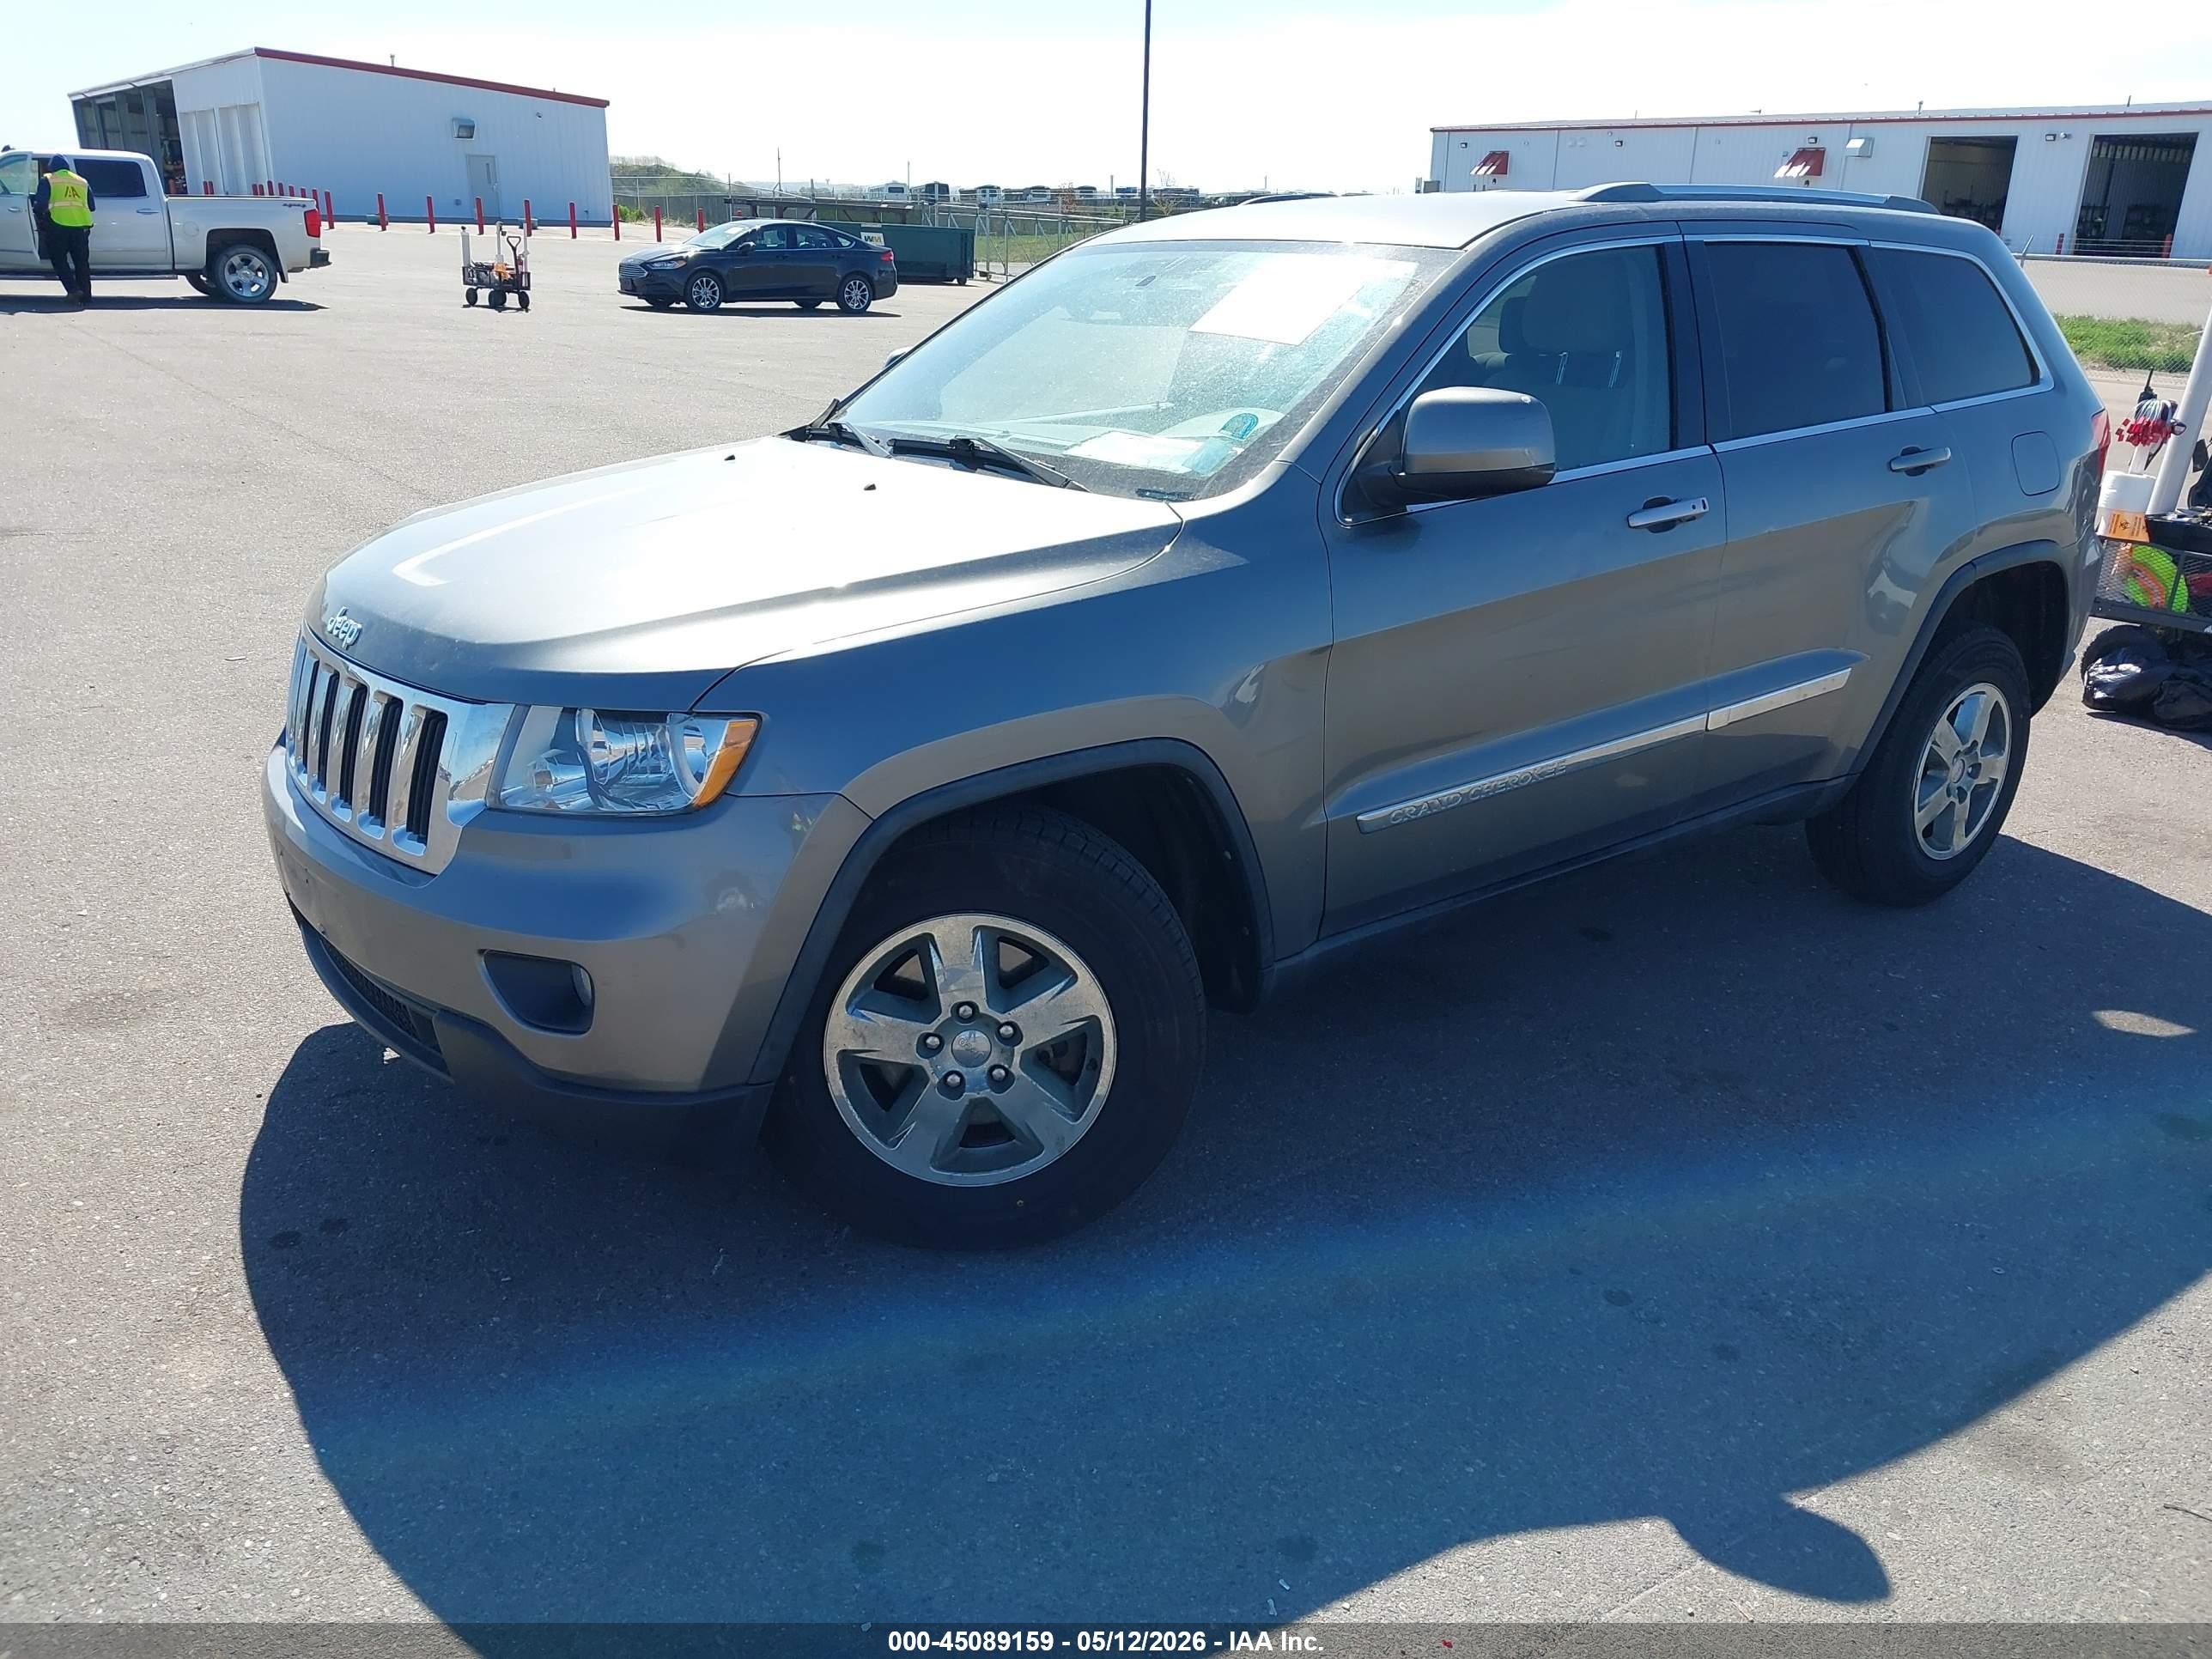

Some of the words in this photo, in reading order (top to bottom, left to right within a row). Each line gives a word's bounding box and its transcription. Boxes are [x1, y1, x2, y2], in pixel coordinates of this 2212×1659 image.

[327, 606, 362, 649] Jeep
[1389, 793, 1462, 824] GRAND
[1468, 759, 1567, 801] CHEROKEE
